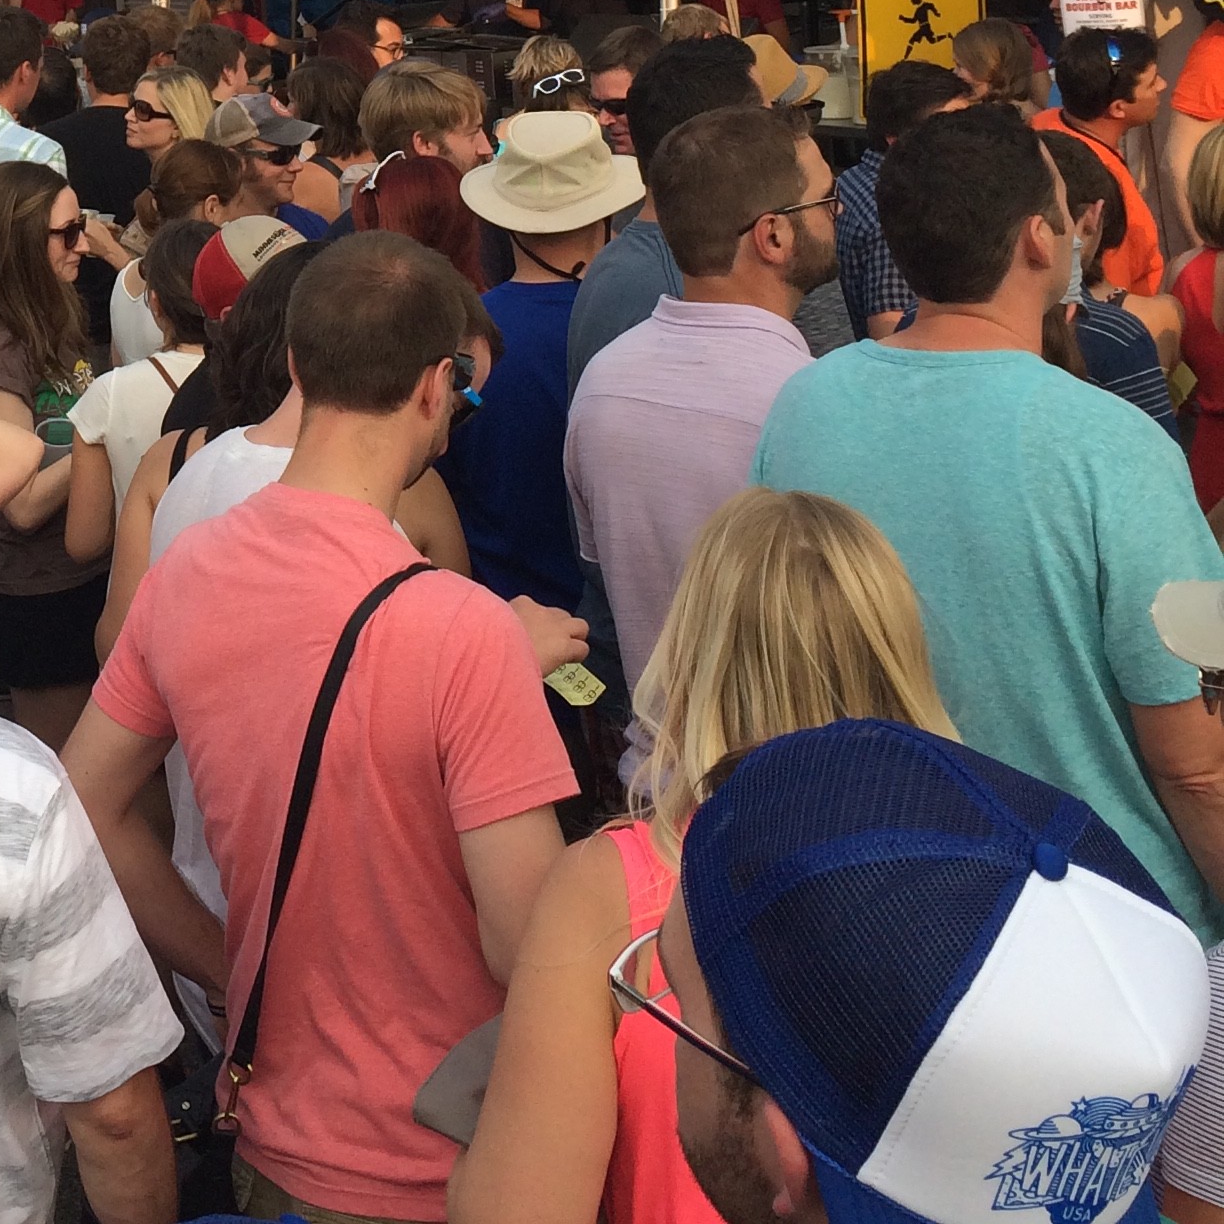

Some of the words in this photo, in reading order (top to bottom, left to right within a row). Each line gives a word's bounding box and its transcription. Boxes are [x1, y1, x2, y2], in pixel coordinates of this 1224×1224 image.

[1065, 2, 1112, 12] BOURBON
[1115, 0, 1138, 10] BAR
[1063, 1206, 1091, 1222] USA
